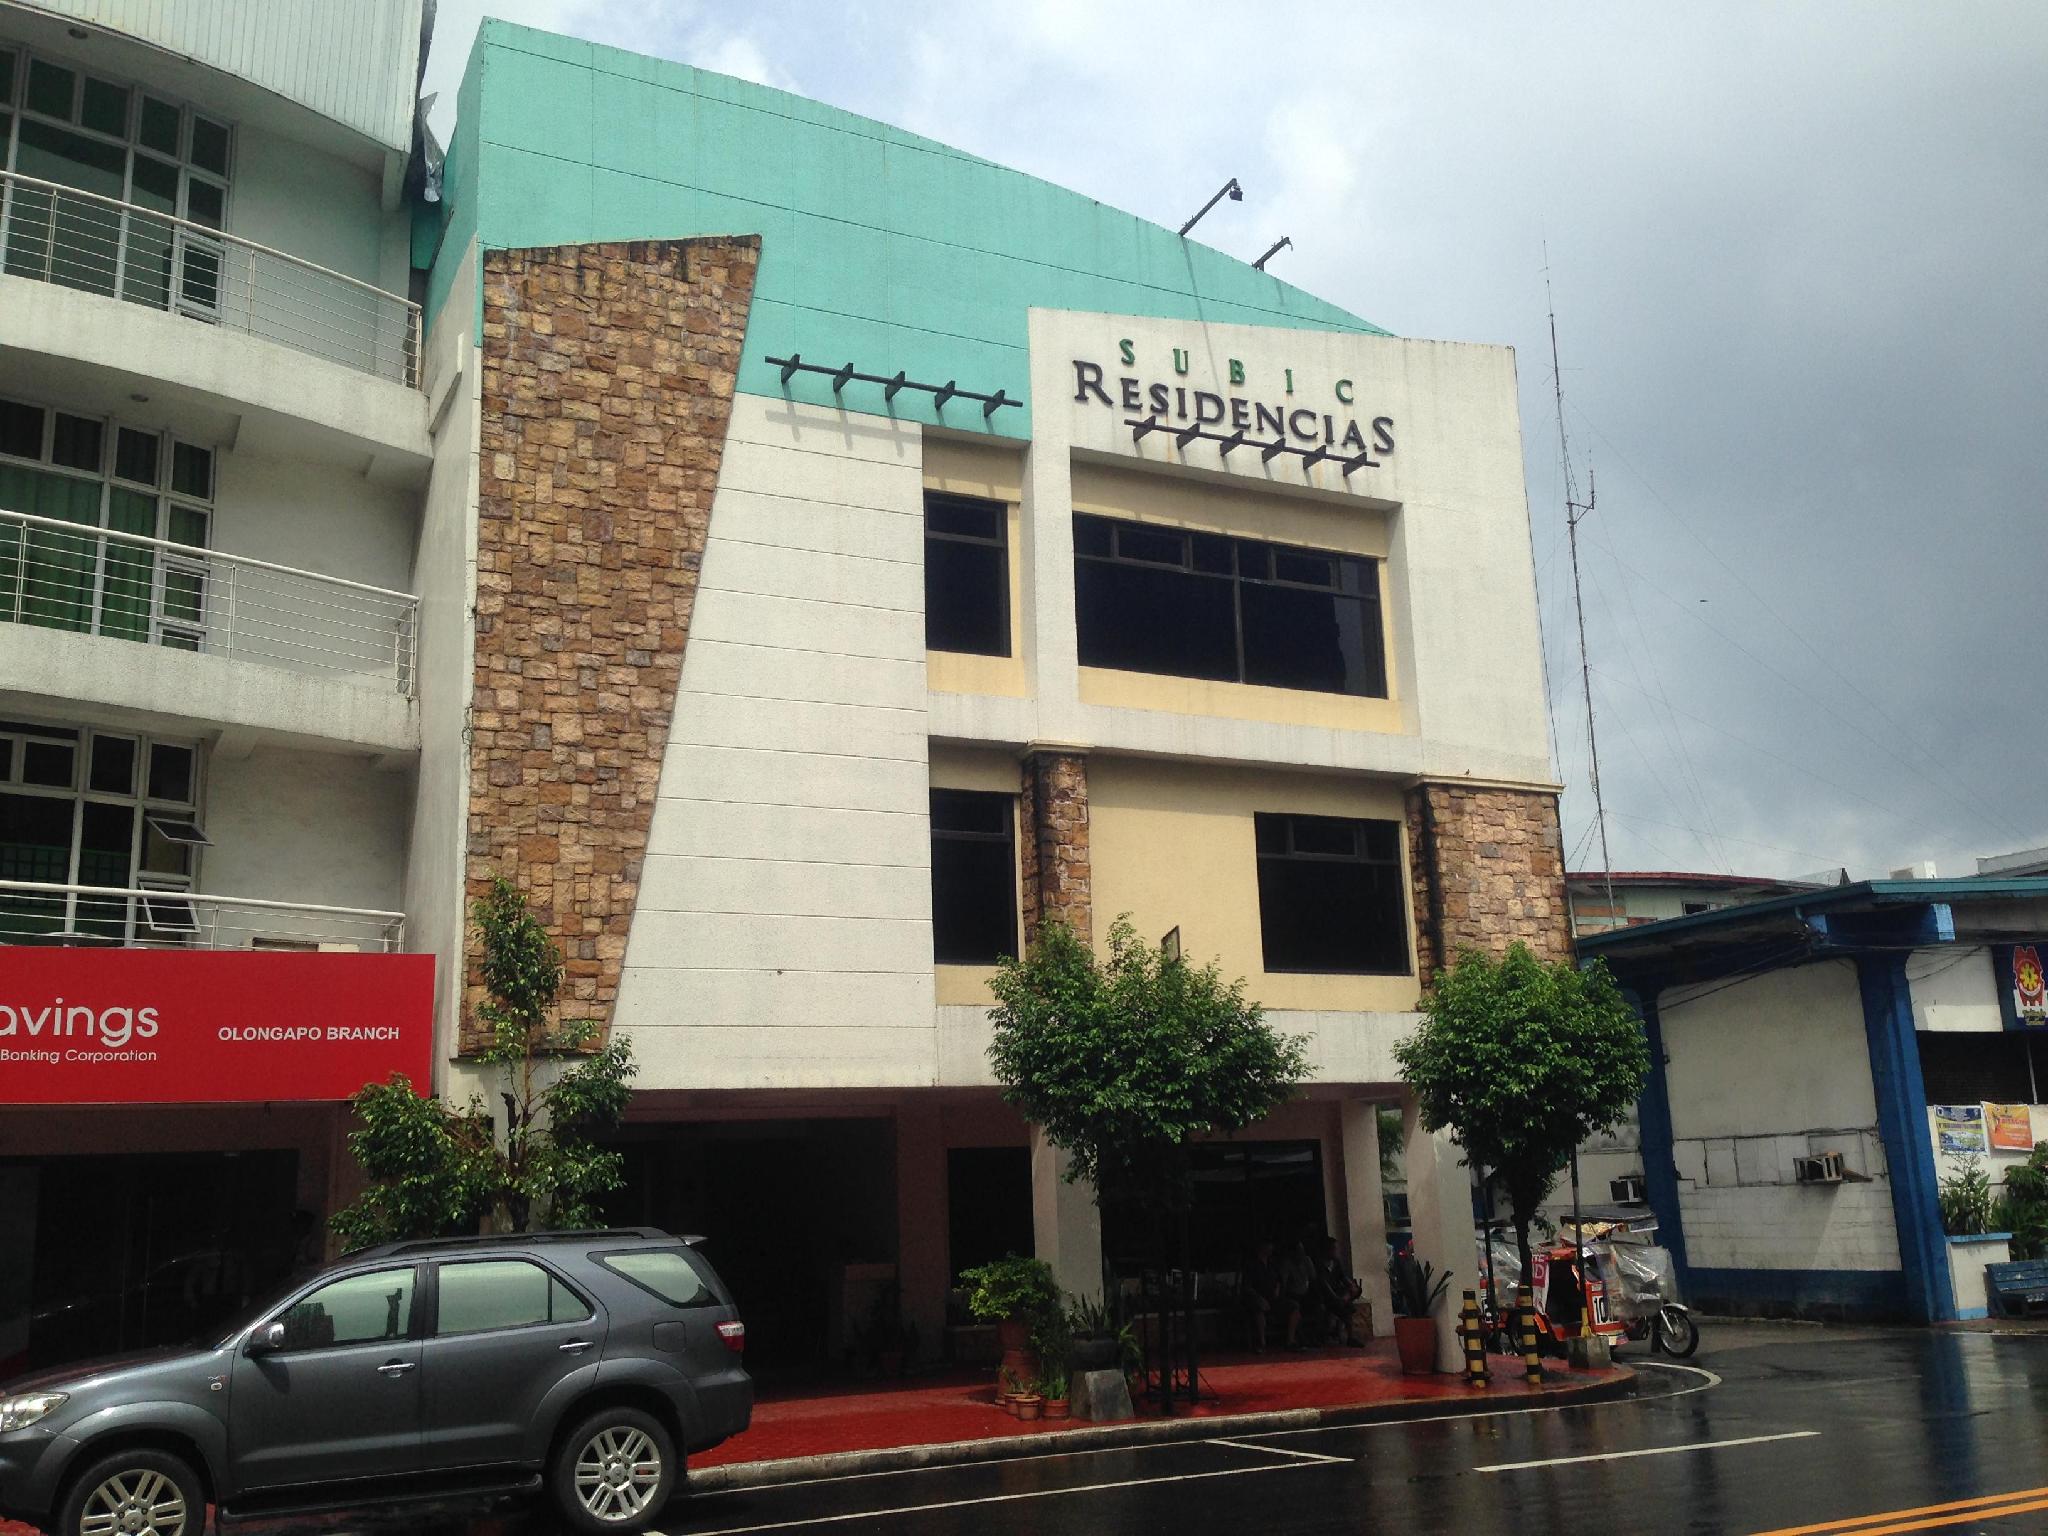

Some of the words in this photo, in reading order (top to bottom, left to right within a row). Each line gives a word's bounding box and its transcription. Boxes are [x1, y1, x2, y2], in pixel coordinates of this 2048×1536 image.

[1119, 338, 1354, 403] SUBIC
[1073, 359, 1396, 453] RESIDENCIAS
[218, 1026, 322, 1041] OLONGAPO
[326, 1026, 400, 1040] BRANCH
[0, 1049, 60, 1064] Banking
[65, 1049, 157, 1064] Corporation
